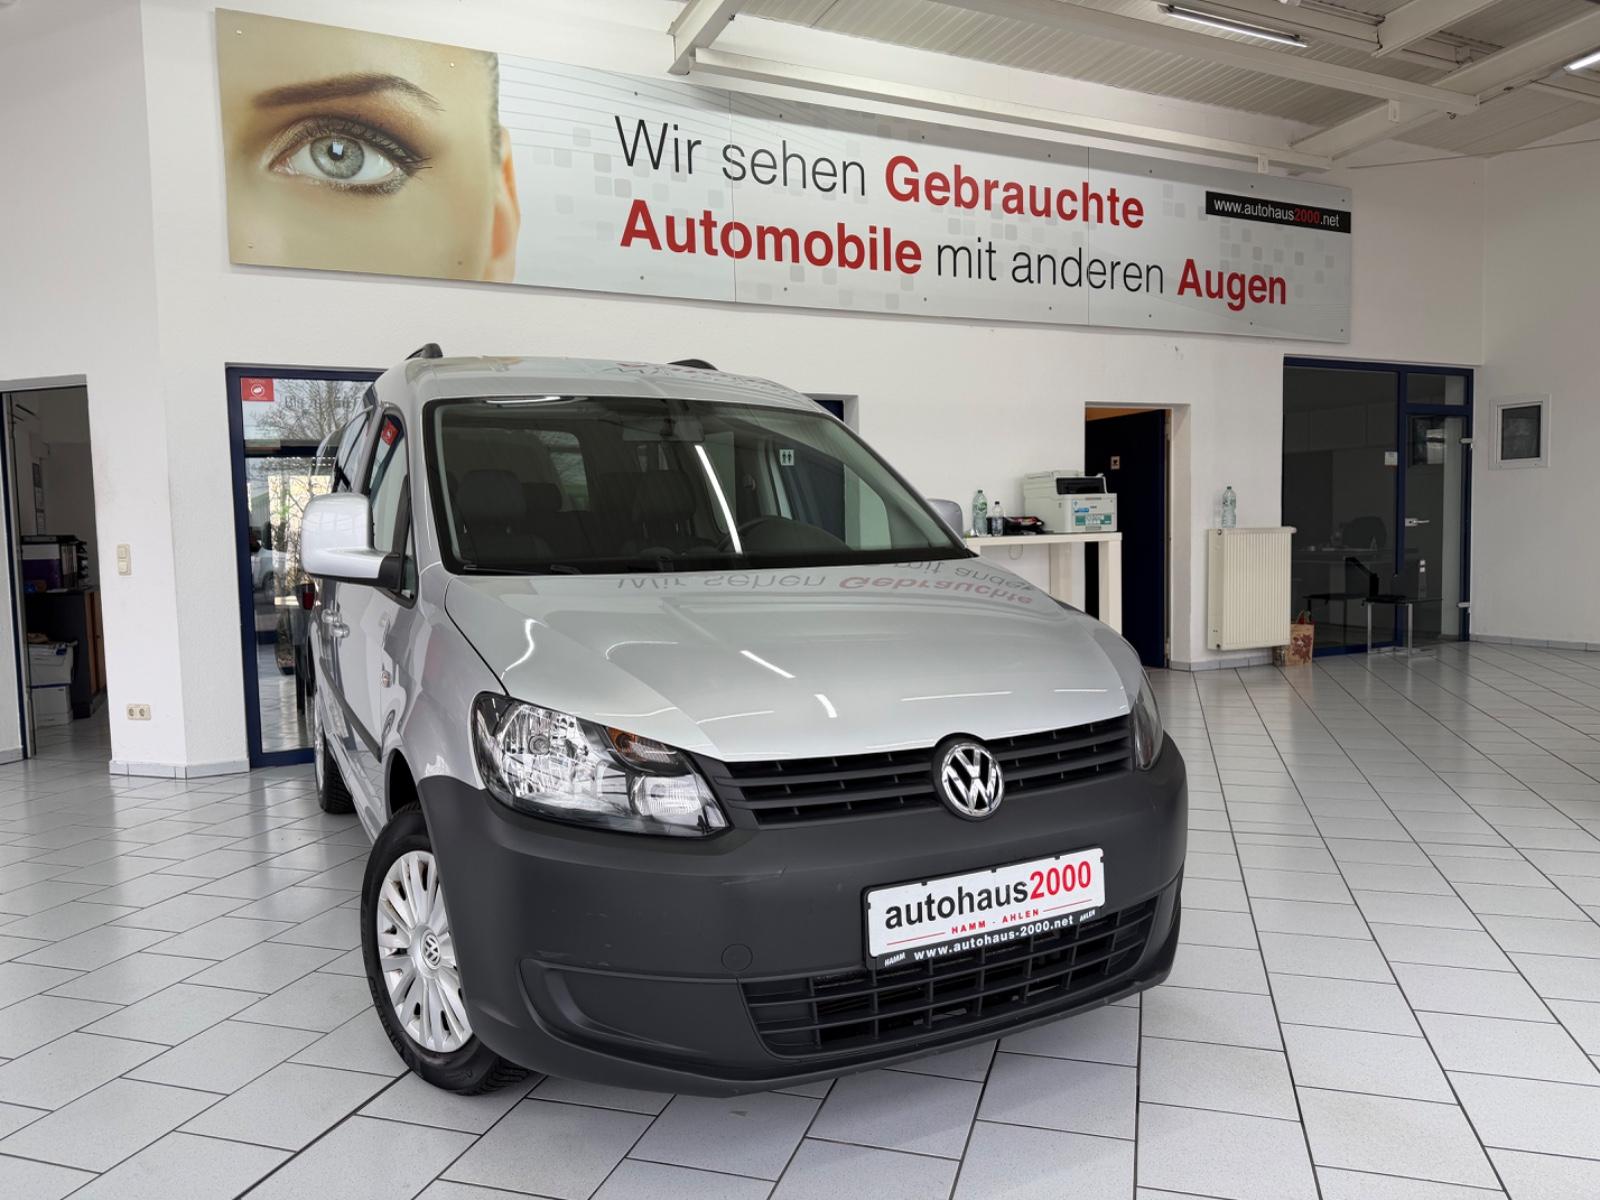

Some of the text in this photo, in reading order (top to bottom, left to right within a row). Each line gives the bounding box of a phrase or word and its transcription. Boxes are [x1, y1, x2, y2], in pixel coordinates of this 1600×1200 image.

[614, 115, 1145, 229] Wir sehen Gebrauchte
[1213, 199, 1340, 228] www.autohaus2000.net
[619, 198, 1287, 312] Automobile mit anderen Augen
[941, 742, 1004, 817] VW
[884, 860, 1092, 930] autohaus2000
[951, 919, 986, 935] HAMM
[1002, 908, 1039, 924] AHLEN
[884, 951, 906, 967] HAMM
[913, 914, 1074, 961] www.autohaus-2000.net
